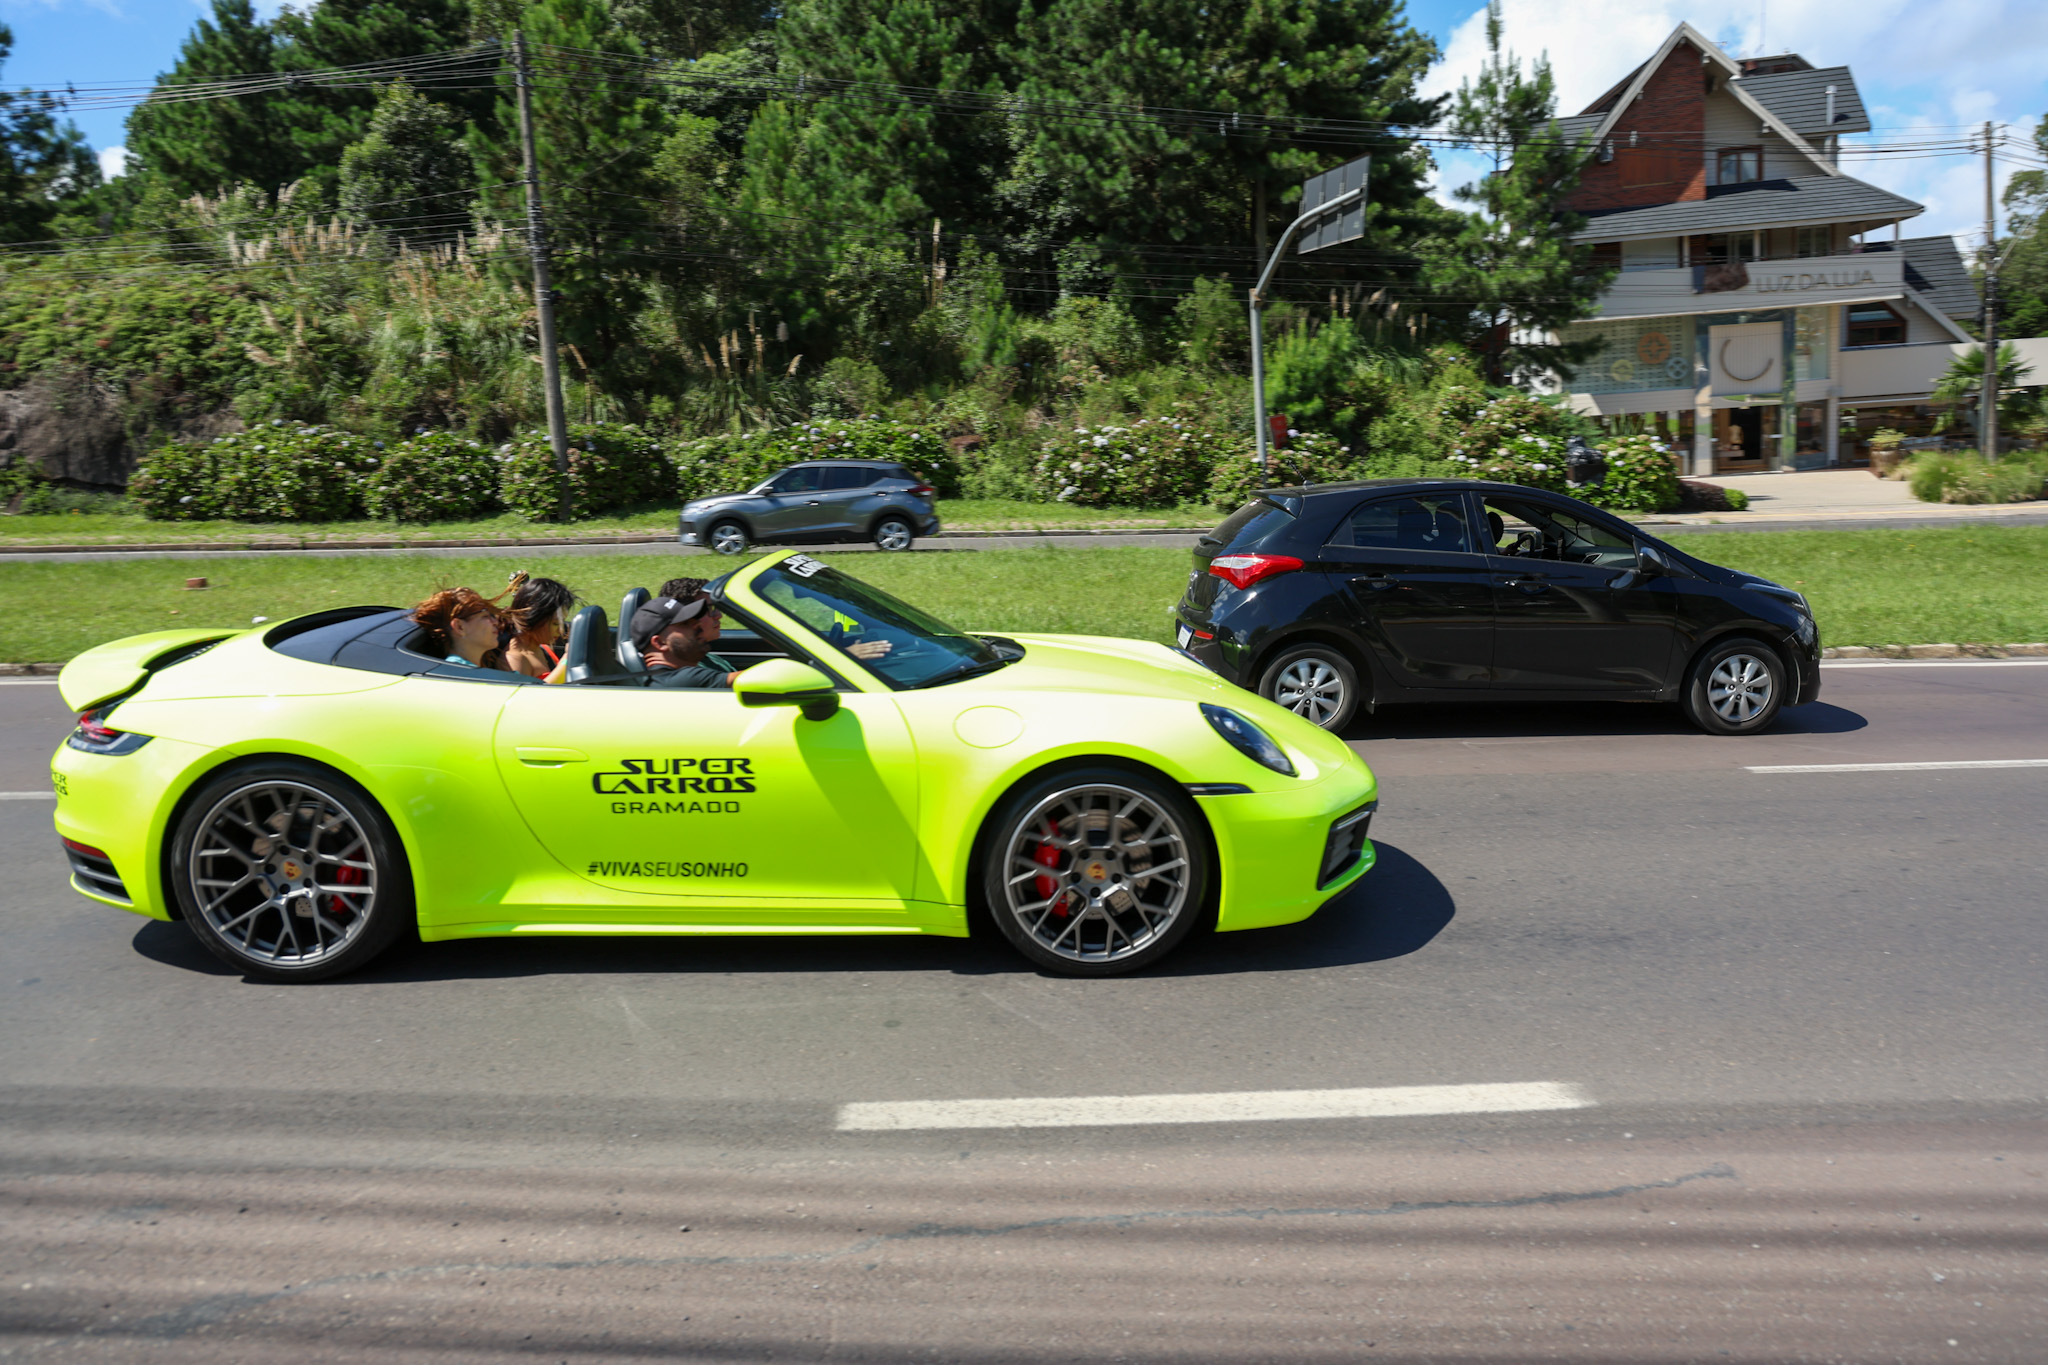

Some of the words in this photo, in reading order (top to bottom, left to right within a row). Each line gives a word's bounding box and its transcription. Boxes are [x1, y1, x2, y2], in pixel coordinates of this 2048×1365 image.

[1756, 274, 1796, 293] LUZ
[1799, 273, 1830, 291] DA
[1832, 269, 1875, 287] LUA
[620, 757, 755, 775] SUPER
[592, 772, 757, 795] CARROS
[611, 801, 741, 814] GRAMADO
[587, 861, 749, 878] #VIVASEUSONHO
